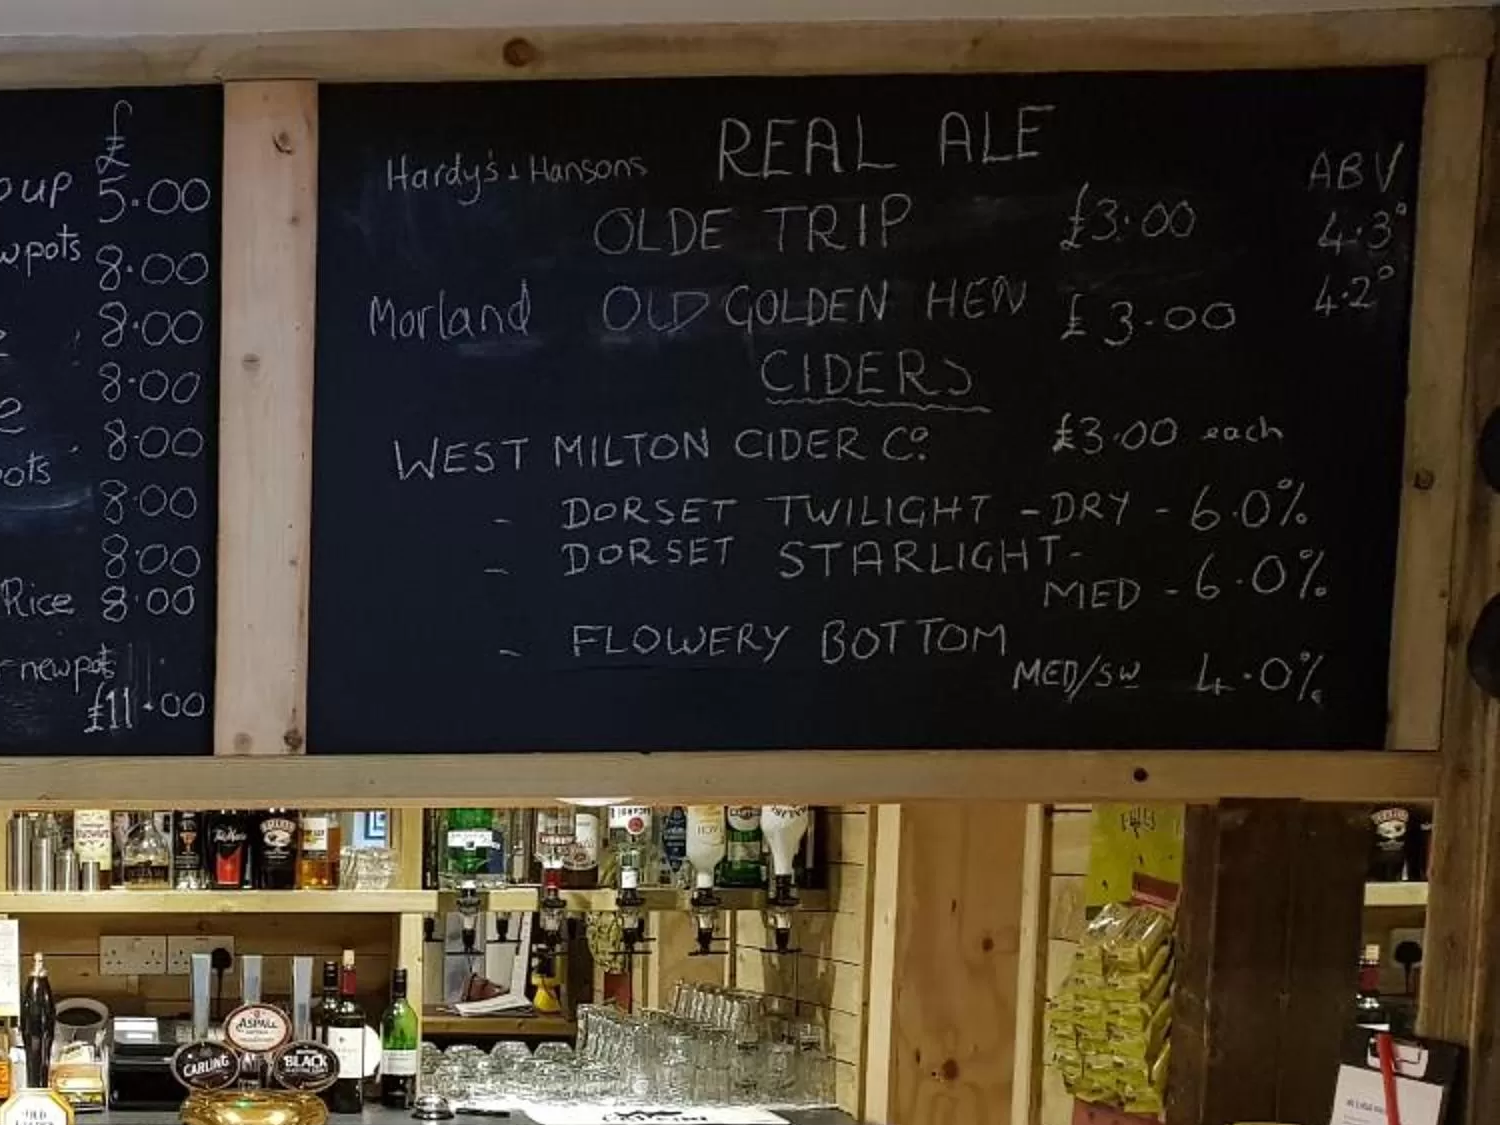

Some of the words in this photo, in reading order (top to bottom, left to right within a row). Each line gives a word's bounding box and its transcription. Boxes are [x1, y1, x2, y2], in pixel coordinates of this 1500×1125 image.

[718, 113, 898, 182] REAL
[939, 104, 1057, 167] ALE
[529, 154, 651, 185] Hansons
[1308, 142, 1405, 193] ABV
[99, 174, 211, 223] 5.00
[594, 206, 734, 257] OLDE
[762, 192, 912, 252] TRIP
[1059, 181, 1197, 251] £3.00
[96, 244, 209, 291] 8.00
[99, 301, 203, 347] 8.00
[368, 277, 532, 343] Morland
[601, 285, 710, 334] OLD
[723, 279, 889, 335] GOLDEN
[926, 275, 1028, 322] HEN
[1060, 293, 1237, 347] £3.00
[99, 361, 201, 404] 8.00
[760, 347, 973, 396] CIDERS
[103, 417, 204, 461] 8.00
[393, 436, 530, 481] WEST
[554, 427, 711, 469] MILTON
[734, 426, 868, 462] CIDER
[1051, 412, 1178, 455] £3.00
[1203, 415, 1284, 443] each
[100, 480, 198, 524] 8.00
[561, 496, 739, 530] DORSET
[765, 494, 994, 529] TWILIGHT
[1050, 490, 1131, 527] DRY
[100, 533, 201, 579] 8.00
[561, 535, 736, 577] DORSET
[1, 576, 77, 619] Rice
[100, 584, 195, 623] 8.00
[1044, 580, 1142, 611] MED
[571, 623, 793, 663] FLOWERY
[820, 618, 1007, 665] BOTTOM
[183, 1053, 231, 1078] CARLING
[283, 1053, 329, 1069] BLACK
